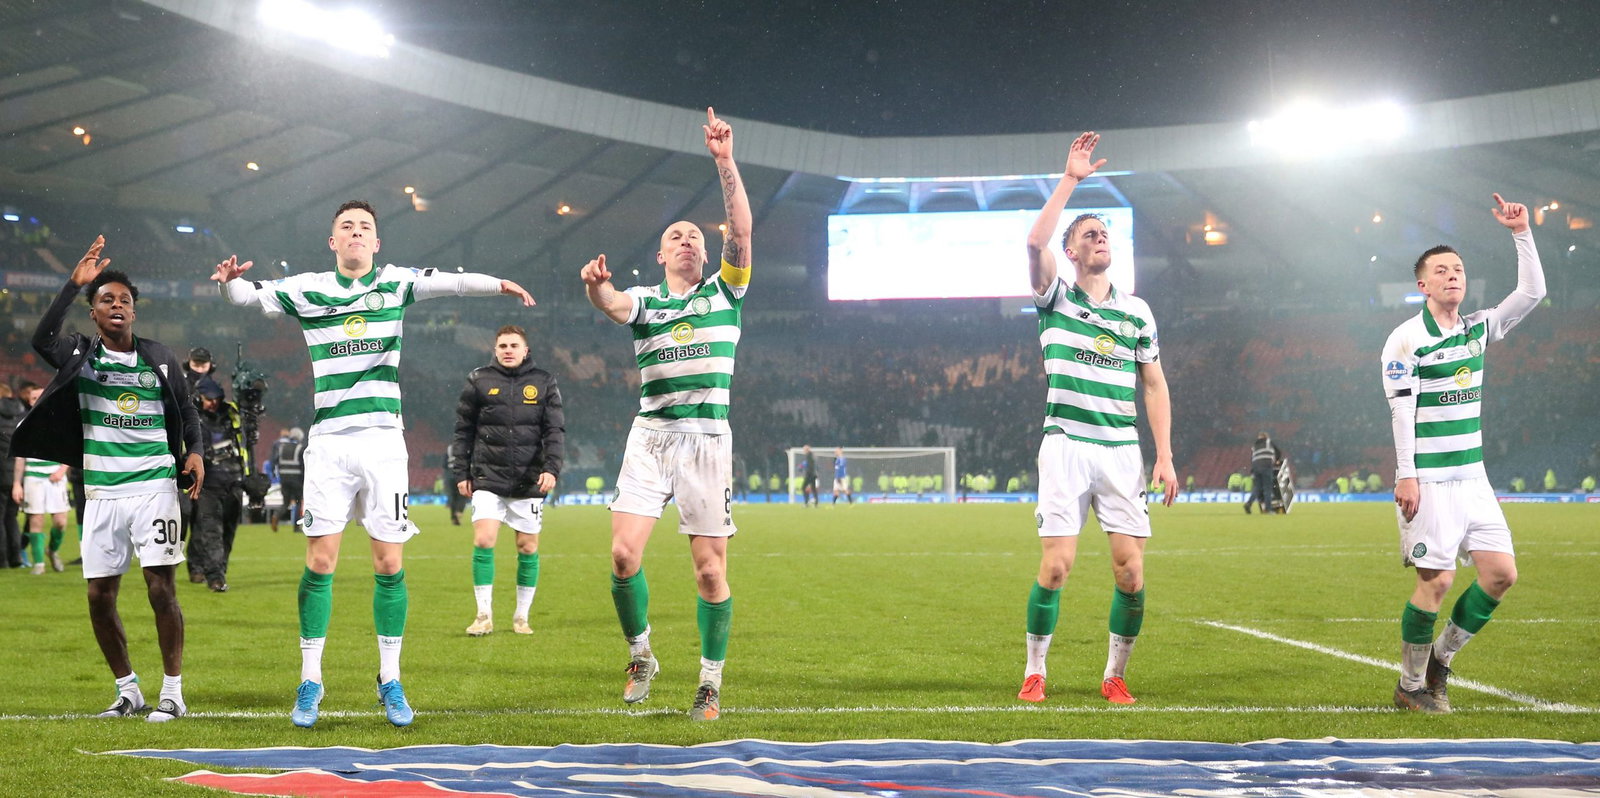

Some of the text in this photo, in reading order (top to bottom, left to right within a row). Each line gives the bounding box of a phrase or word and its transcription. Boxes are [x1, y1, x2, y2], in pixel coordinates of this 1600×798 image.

[330, 339, 383, 356] dafabet
[658, 344, 711, 361] dafabet
[1074, 350, 1124, 369] dafabet
[103, 414, 154, 429] dafabet
[725, 487, 731, 514] 8
[152, 518, 178, 546] 30
